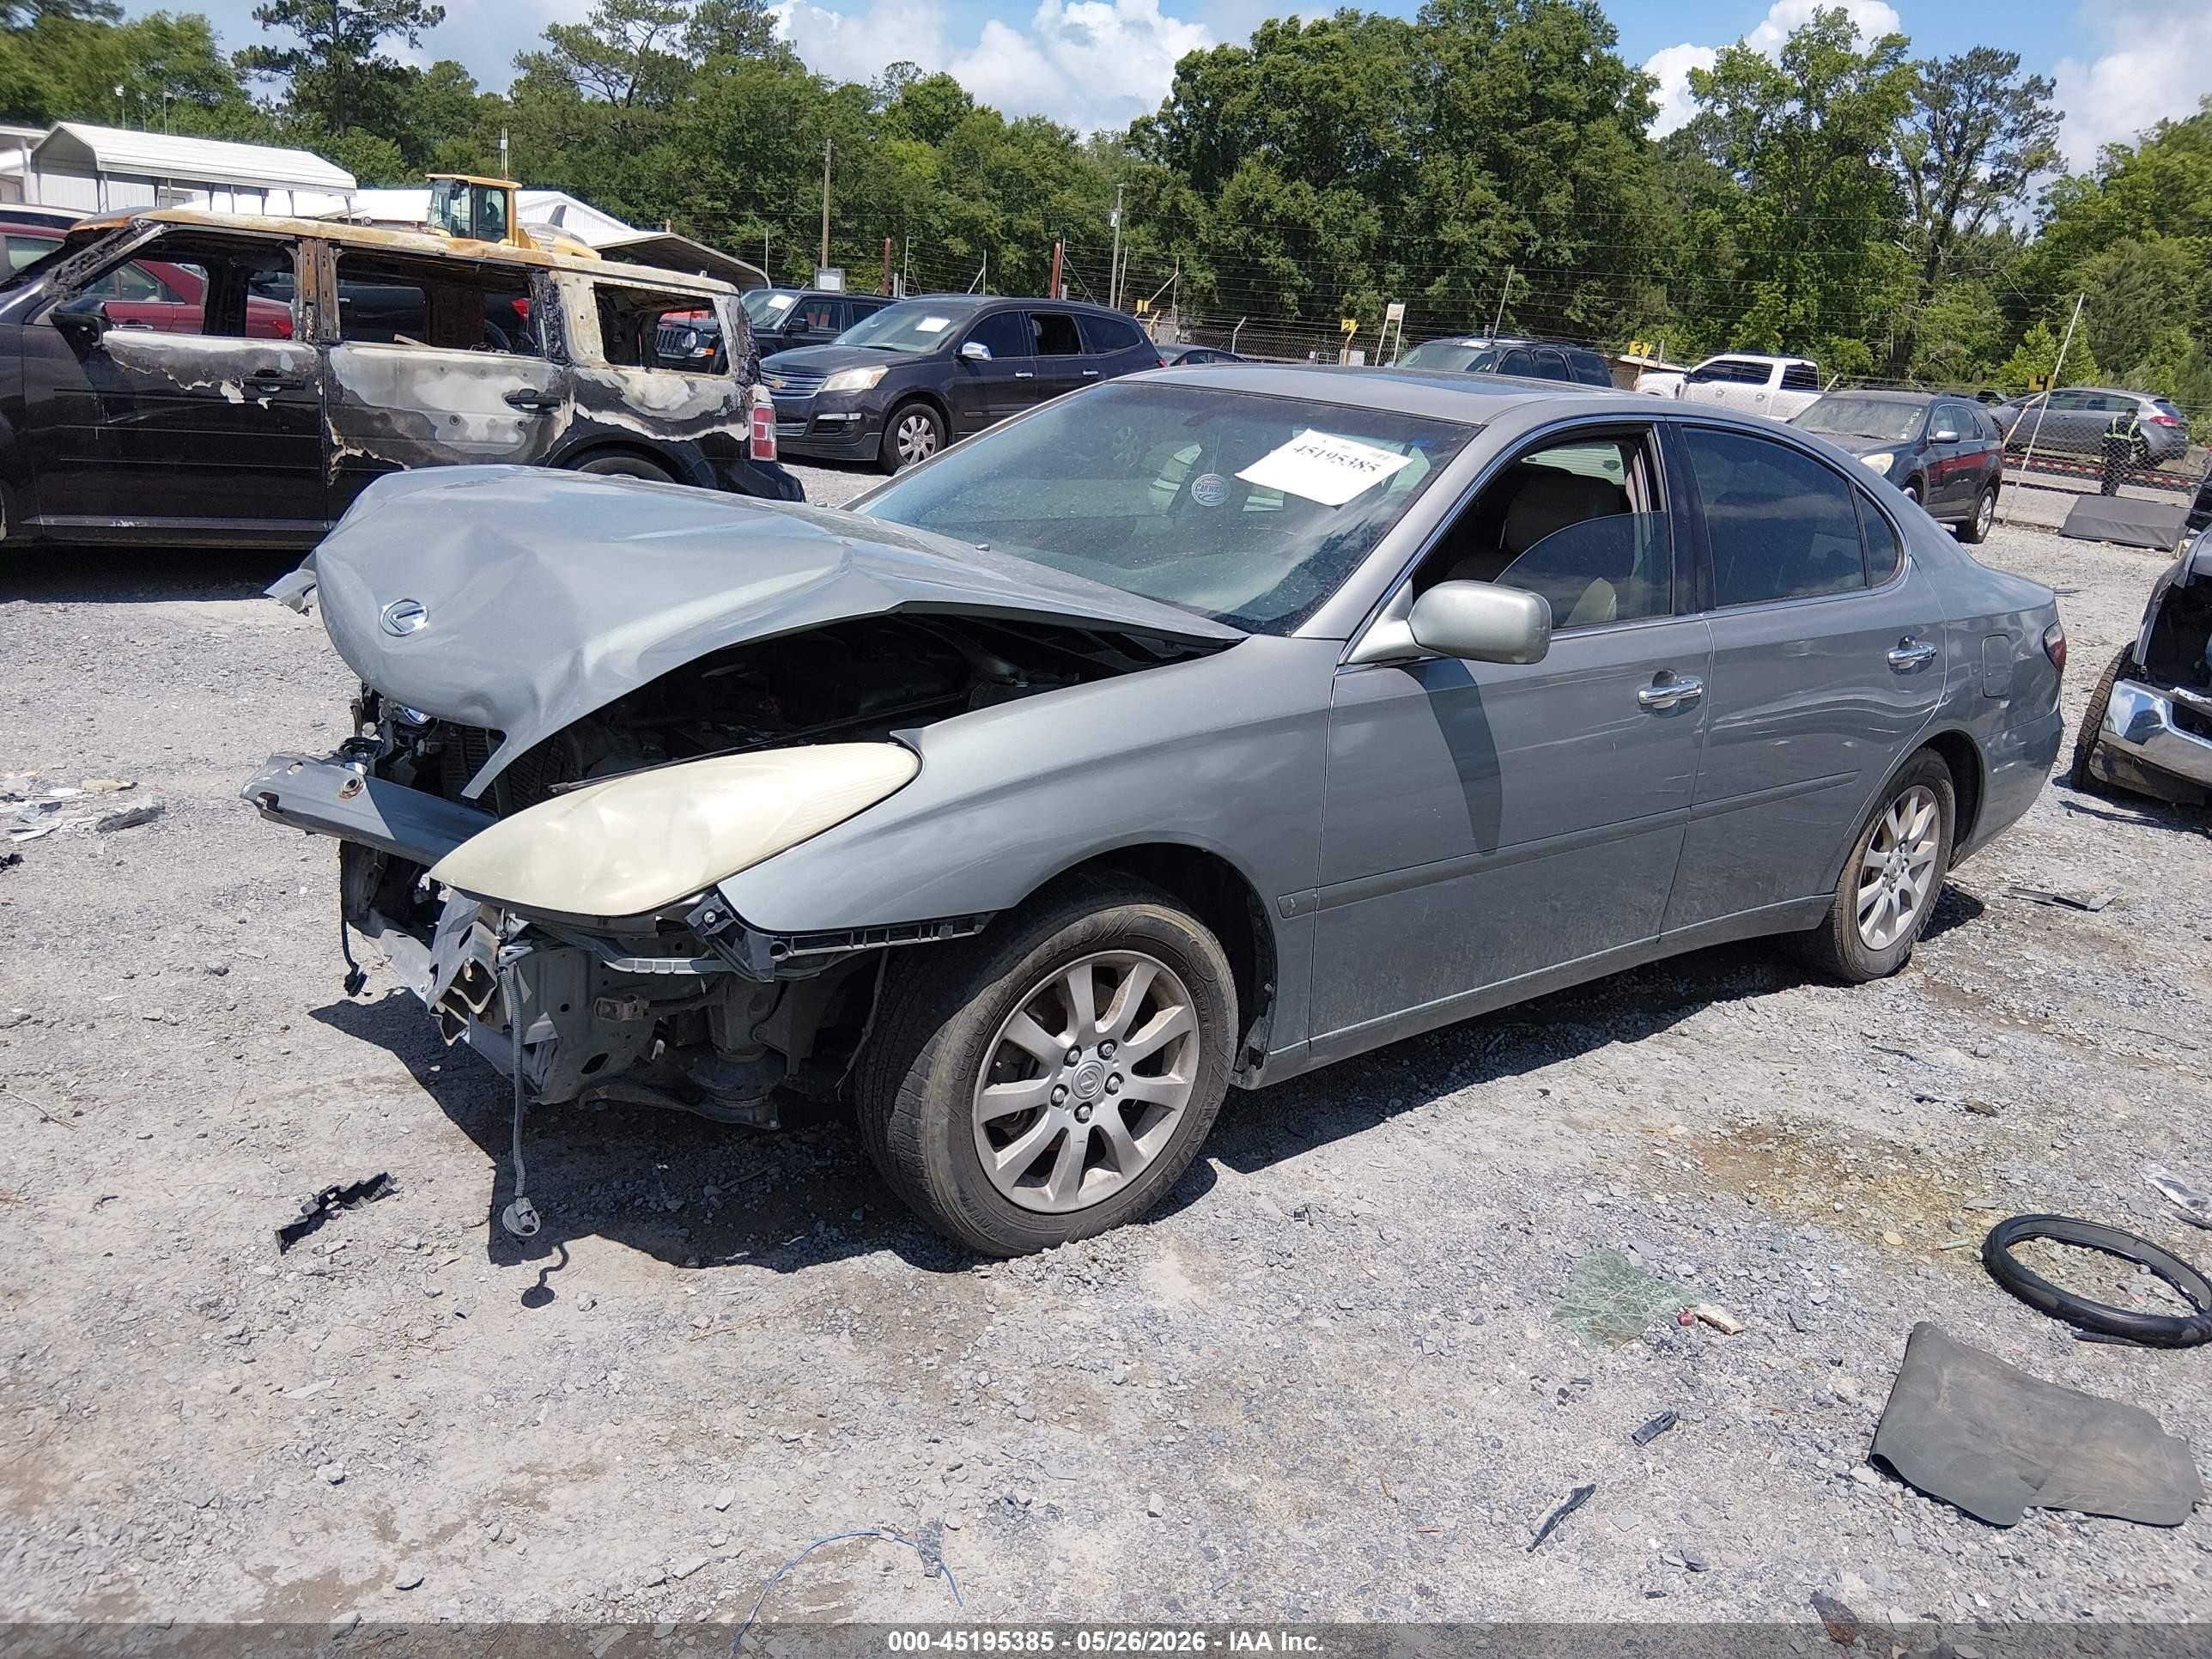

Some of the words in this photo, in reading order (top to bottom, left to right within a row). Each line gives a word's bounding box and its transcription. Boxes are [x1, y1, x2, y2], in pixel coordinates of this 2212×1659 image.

[1344, 321, 1351, 330] 2
[1633, 342, 1644, 356] 3
[2036, 374, 2049, 391] 4
[1293, 445, 1382, 473] 45195385
